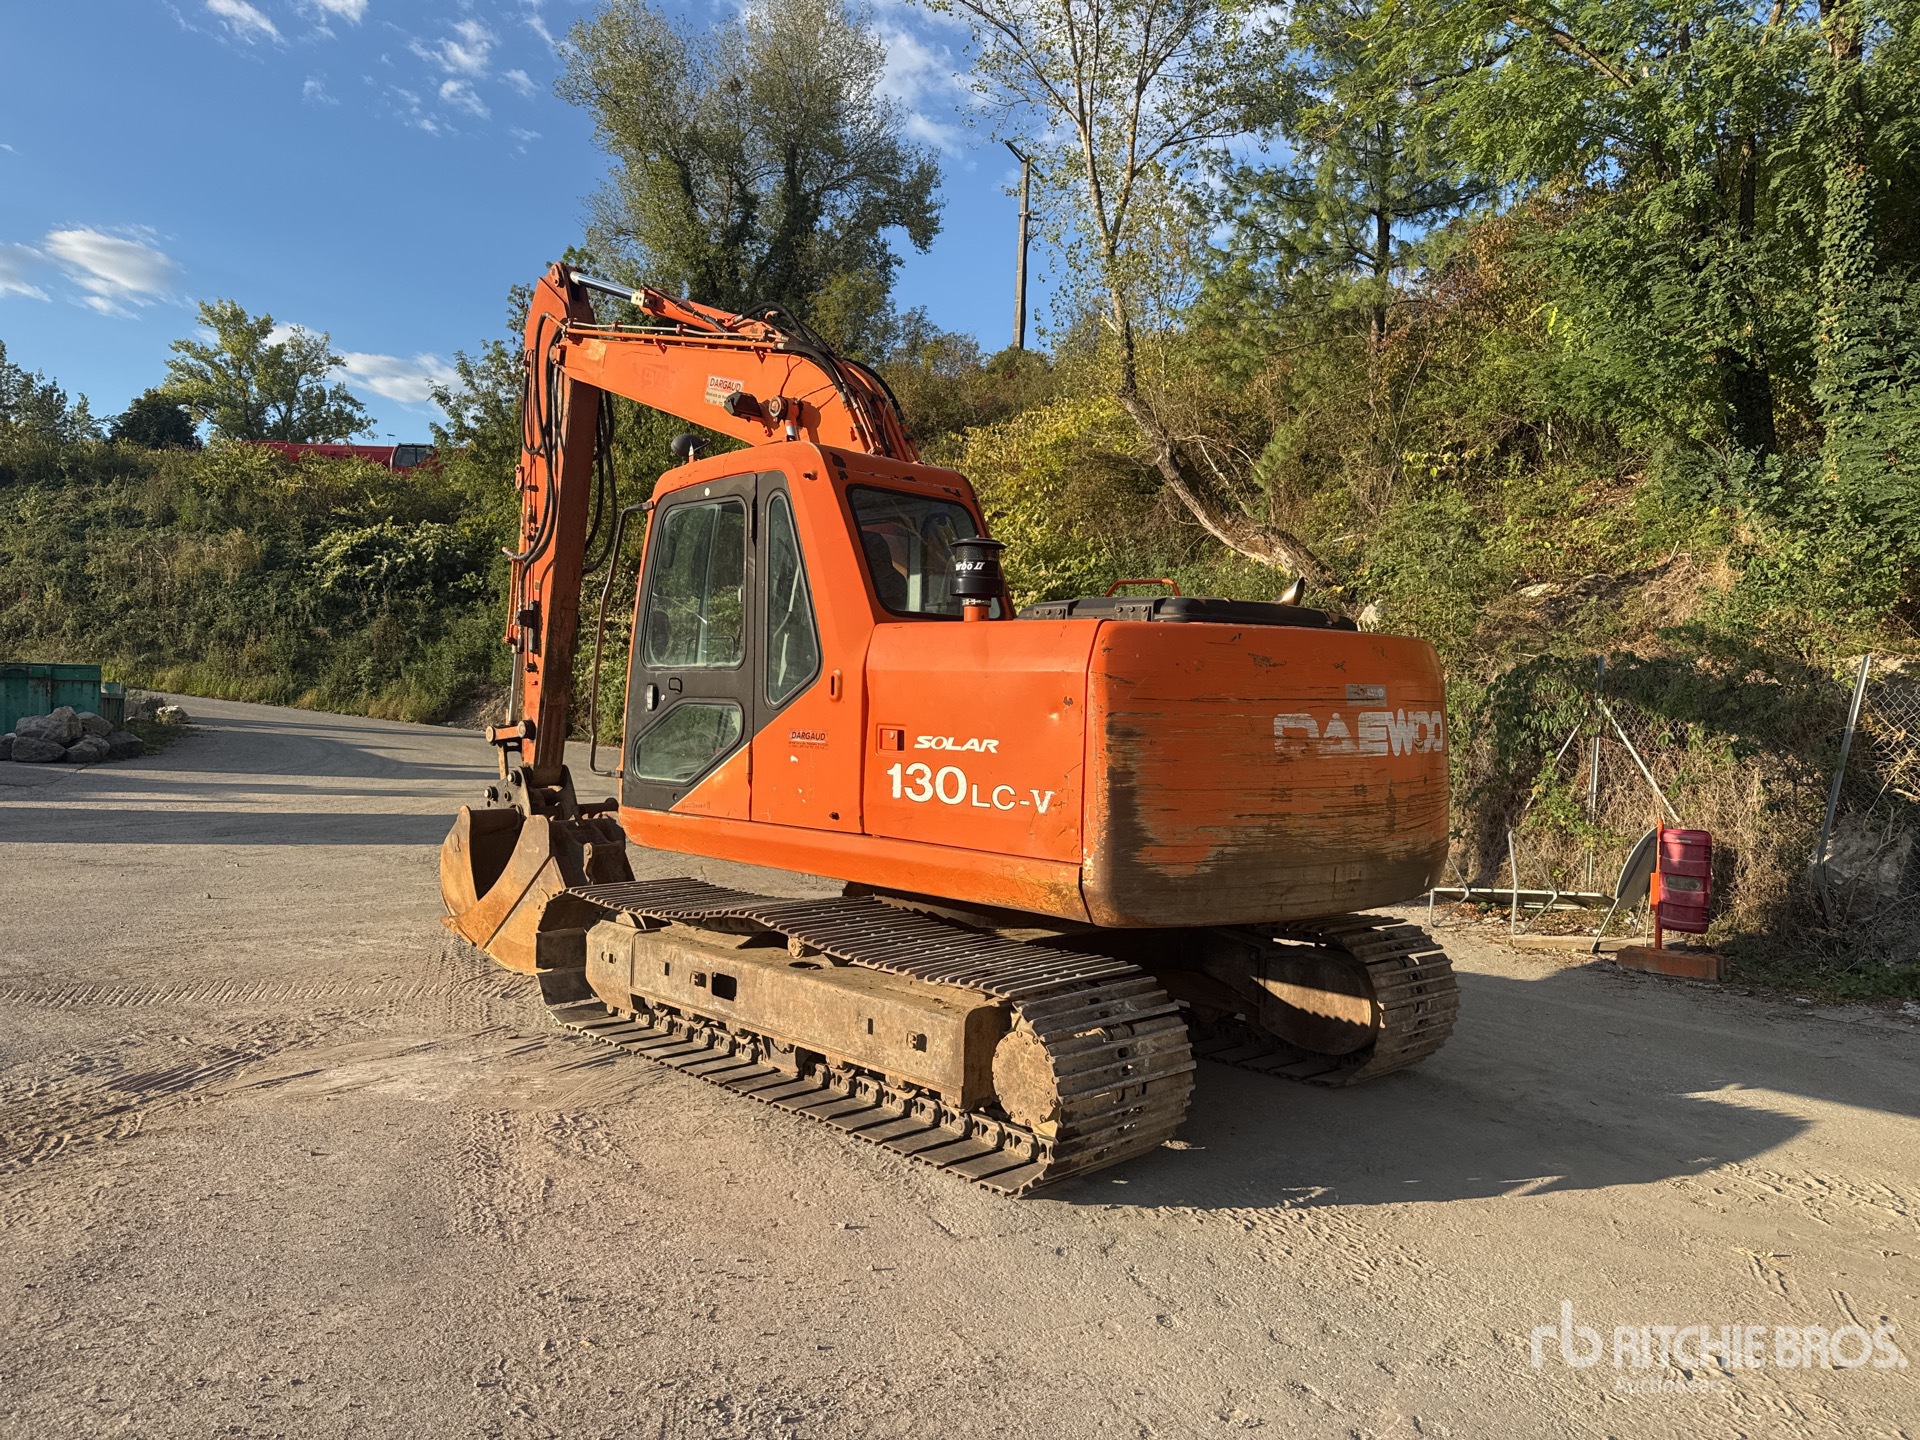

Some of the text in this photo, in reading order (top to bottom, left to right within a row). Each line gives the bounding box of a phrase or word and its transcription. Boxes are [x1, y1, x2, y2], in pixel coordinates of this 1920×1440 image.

[709, 377, 742, 392] DARGAUD
[791, 731, 826, 741] DARGAUD
[1273, 708, 1444, 758] DAEWOO
[913, 735, 1000, 754] SOLAR
